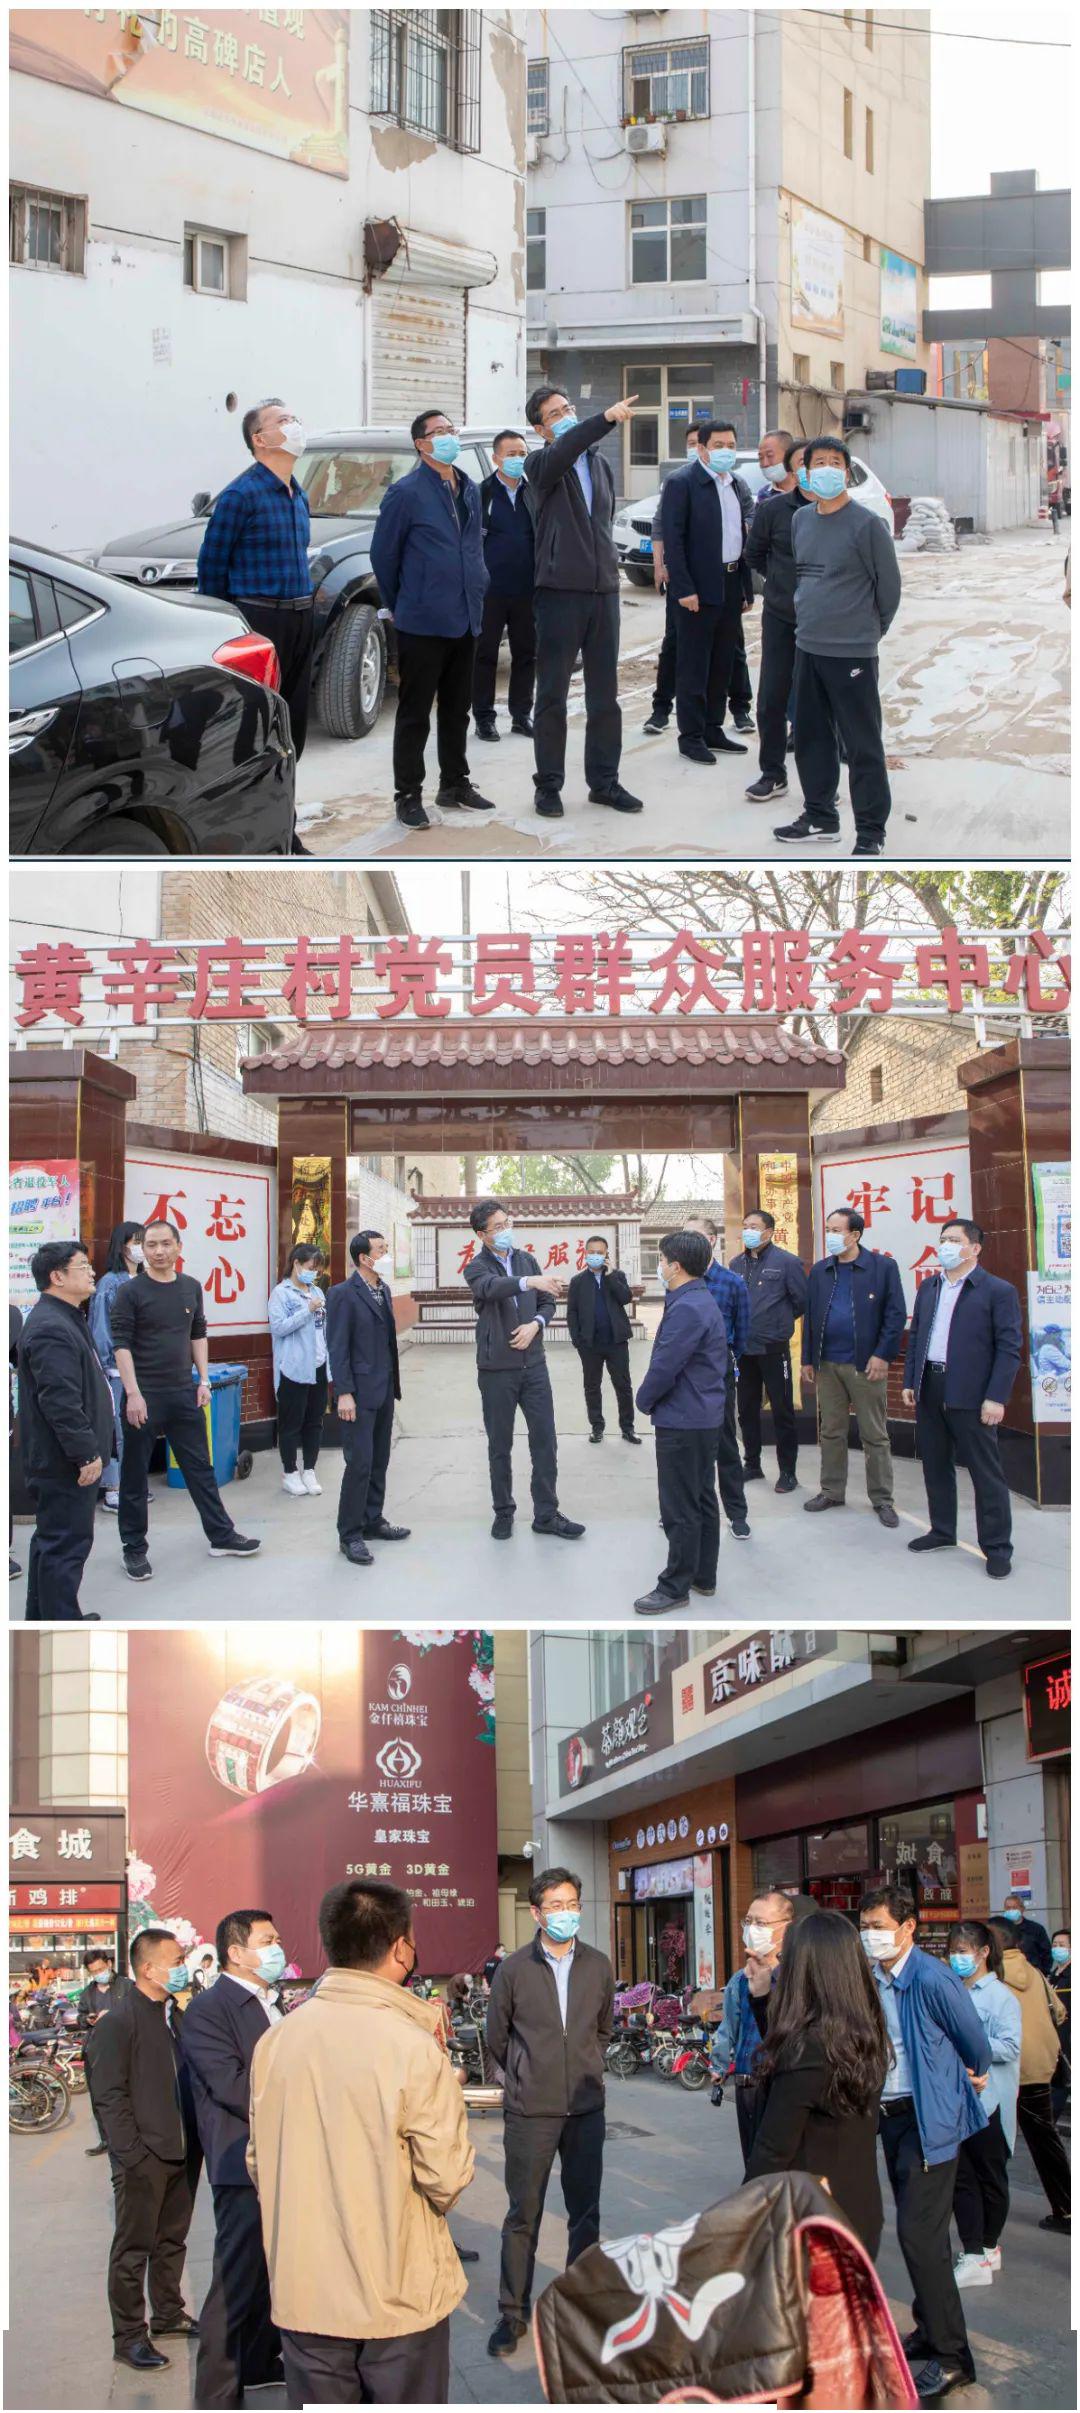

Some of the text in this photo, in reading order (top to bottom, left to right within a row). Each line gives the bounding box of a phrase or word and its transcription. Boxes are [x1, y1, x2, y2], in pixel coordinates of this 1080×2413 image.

[15, 927, 1070, 1027] 黄辛庄村党员群众服务中心
[846, 1172, 958, 1228] 牢记
[143, 1190, 246, 1241] 不忘
[369, 1703, 389, 1712] KAM
[379, 1779, 422, 1788] HUAXIFU
[9, 1828, 93, 1860] 食城
[374, 1829, 431, 1843] 皇家珠宝
[346, 1863, 450, 1876] 5G黄金 3D黄金
